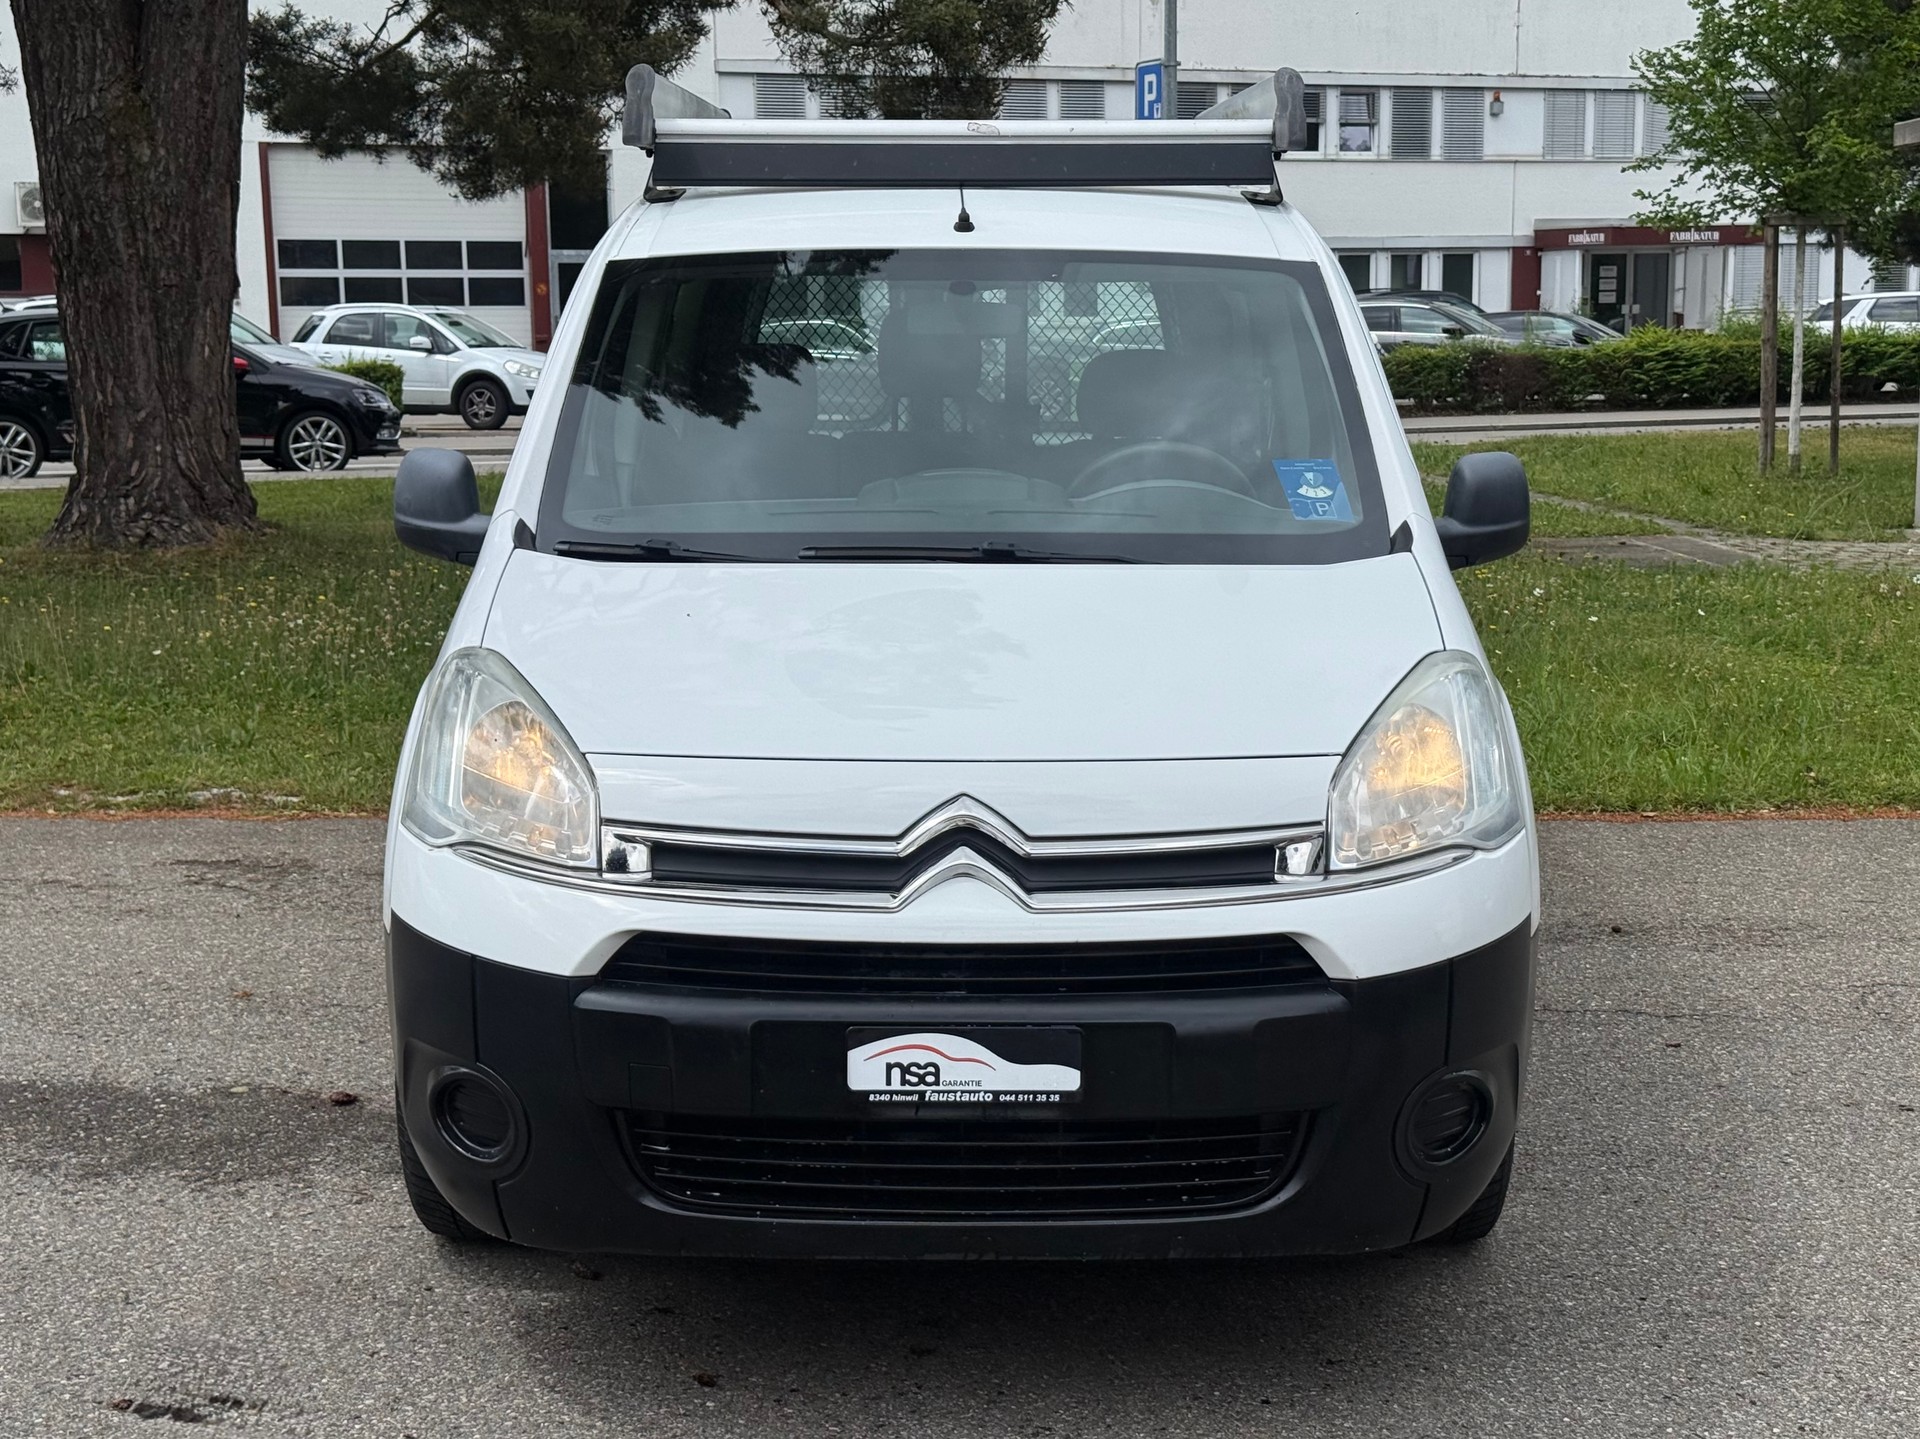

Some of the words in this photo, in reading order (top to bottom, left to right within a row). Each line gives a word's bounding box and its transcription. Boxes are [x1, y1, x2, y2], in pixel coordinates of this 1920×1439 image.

[1143, 73, 1157, 117] P
[1670, 228, 1719, 242] FABRIKATUR
[1315, 502, 1330, 516] P
[885, 1061, 941, 1087] nsa
[941, 1079, 983, 1087] GARANTIE
[868, 1093, 891, 1102] 8340
[891, 1093, 919, 1102] hinwil
[924, 1090, 993, 1102] faustauto
[999, 1094, 1016, 1102] 044
[1017, 1094, 1034, 1102] 511
[1035, 1094, 1047, 1102] 35
[1048, 1094, 1060, 1102] 35
